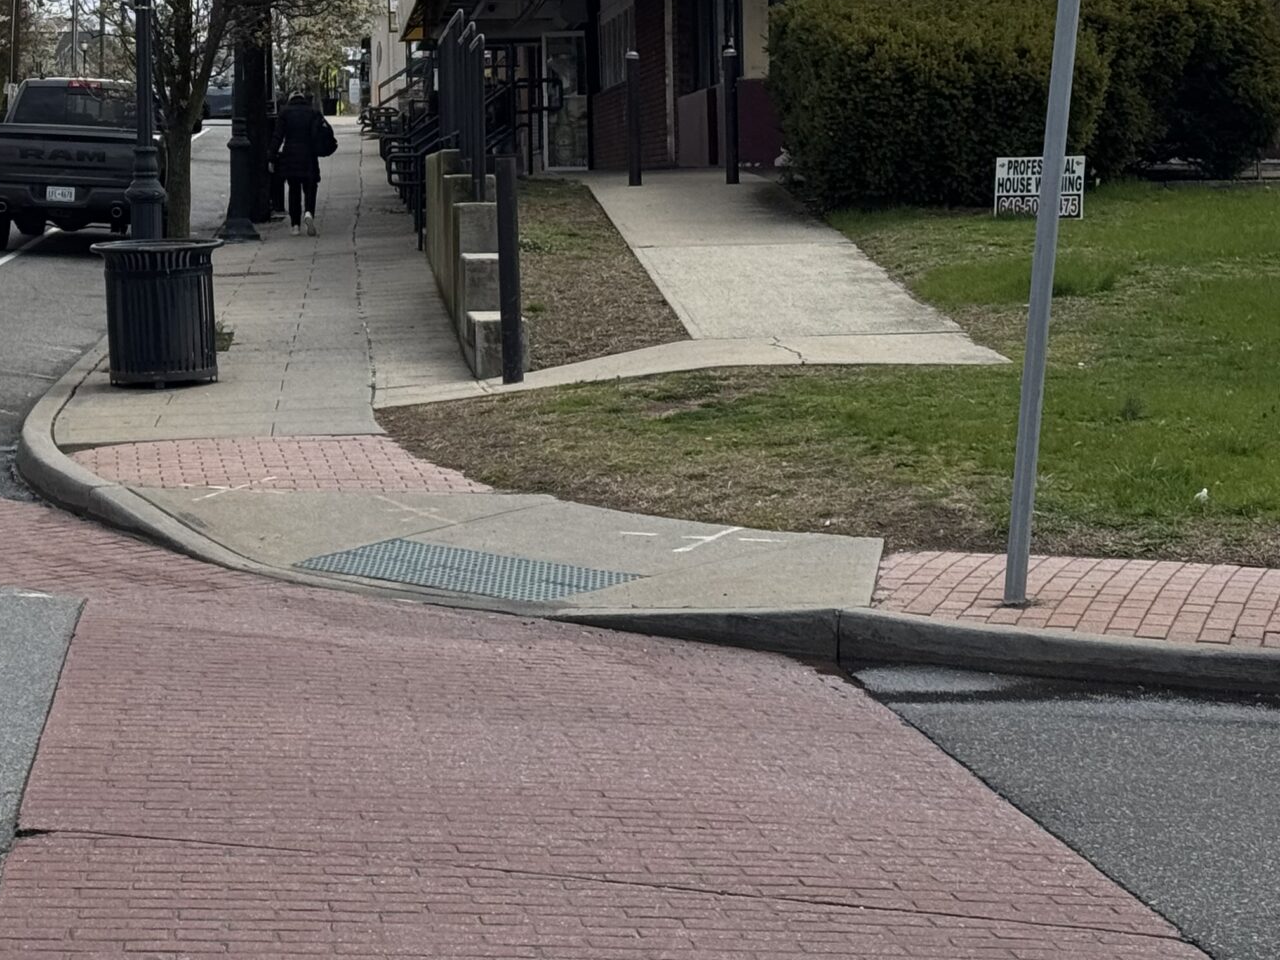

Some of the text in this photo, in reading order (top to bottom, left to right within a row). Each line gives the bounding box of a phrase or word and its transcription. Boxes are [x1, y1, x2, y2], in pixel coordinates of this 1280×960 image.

[19, 148, 106, 163] RAM
[1007, 158, 1076, 176] PROFESAL
[997, 176, 1082, 194] HOUSE WING
